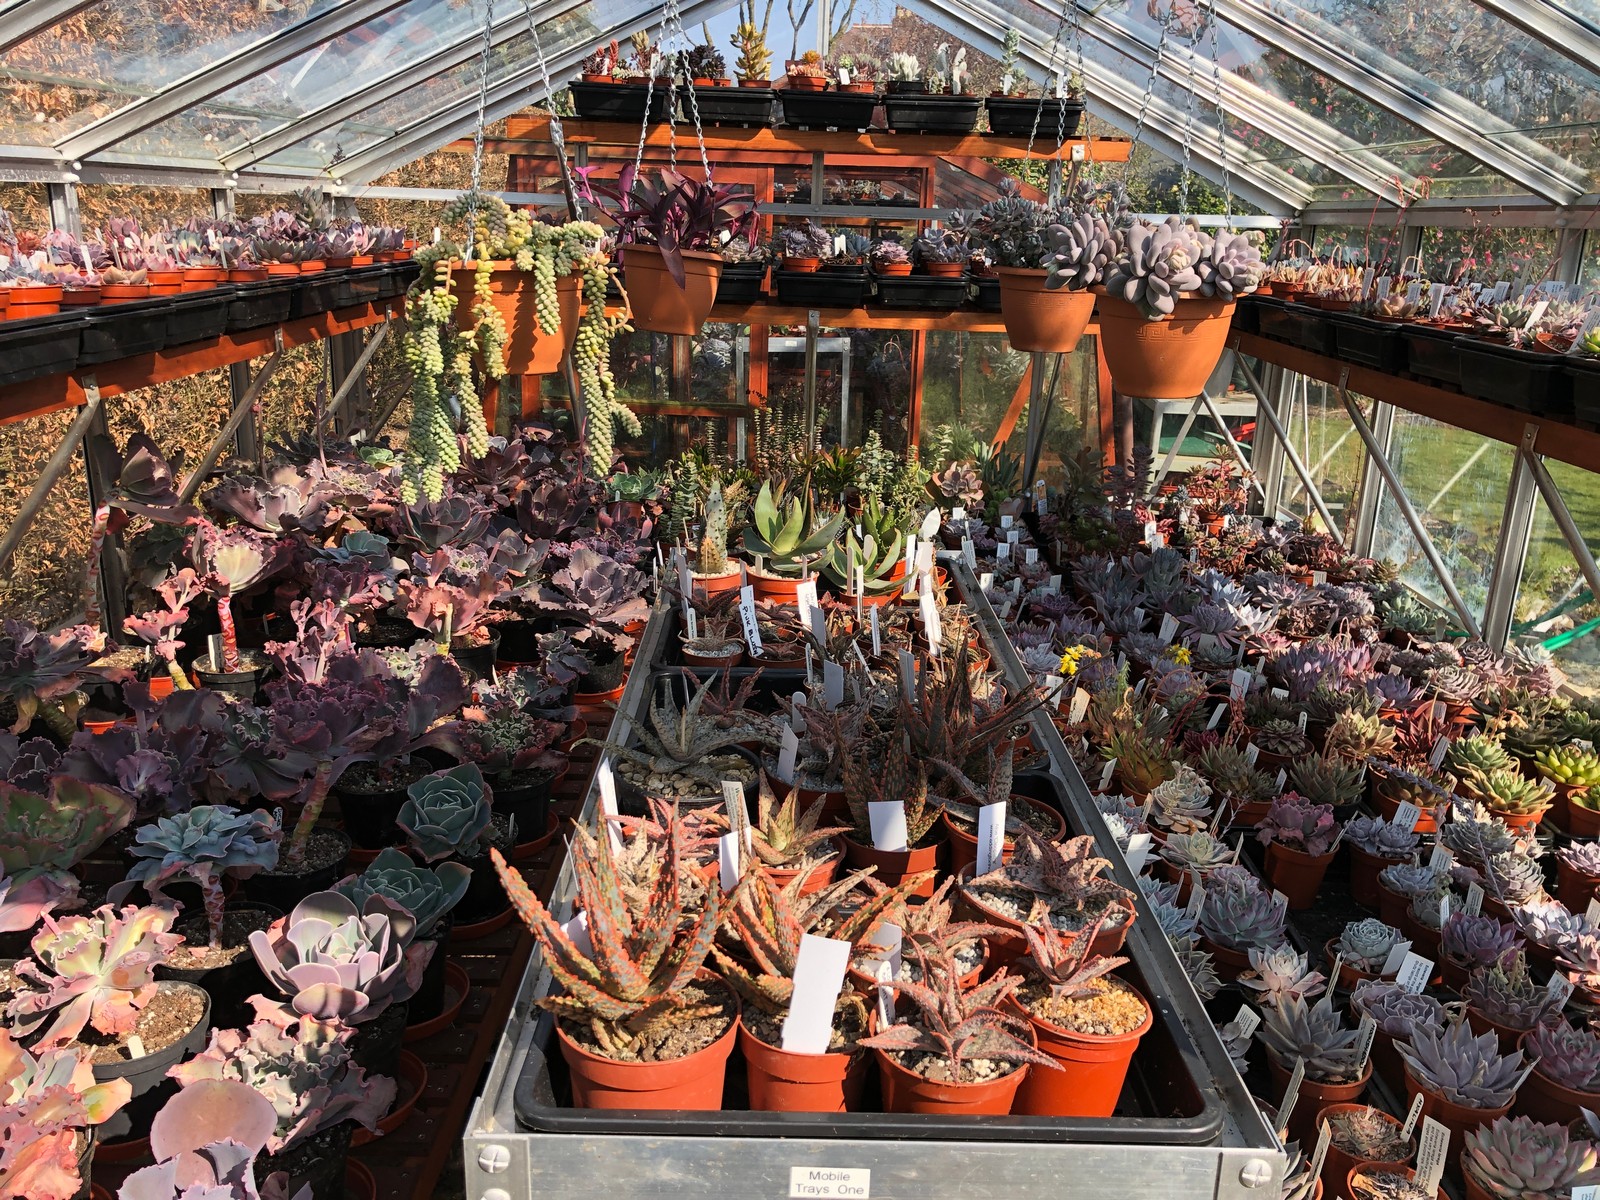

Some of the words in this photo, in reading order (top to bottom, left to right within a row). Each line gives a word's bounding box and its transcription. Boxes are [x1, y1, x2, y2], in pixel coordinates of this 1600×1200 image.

[1406, 1099, 1422, 1135] HYALINA
[809, 1171, 850, 1181] Mobile
[796, 1183, 830, 1195] Trays
[838, 1185, 864, 1194] One
